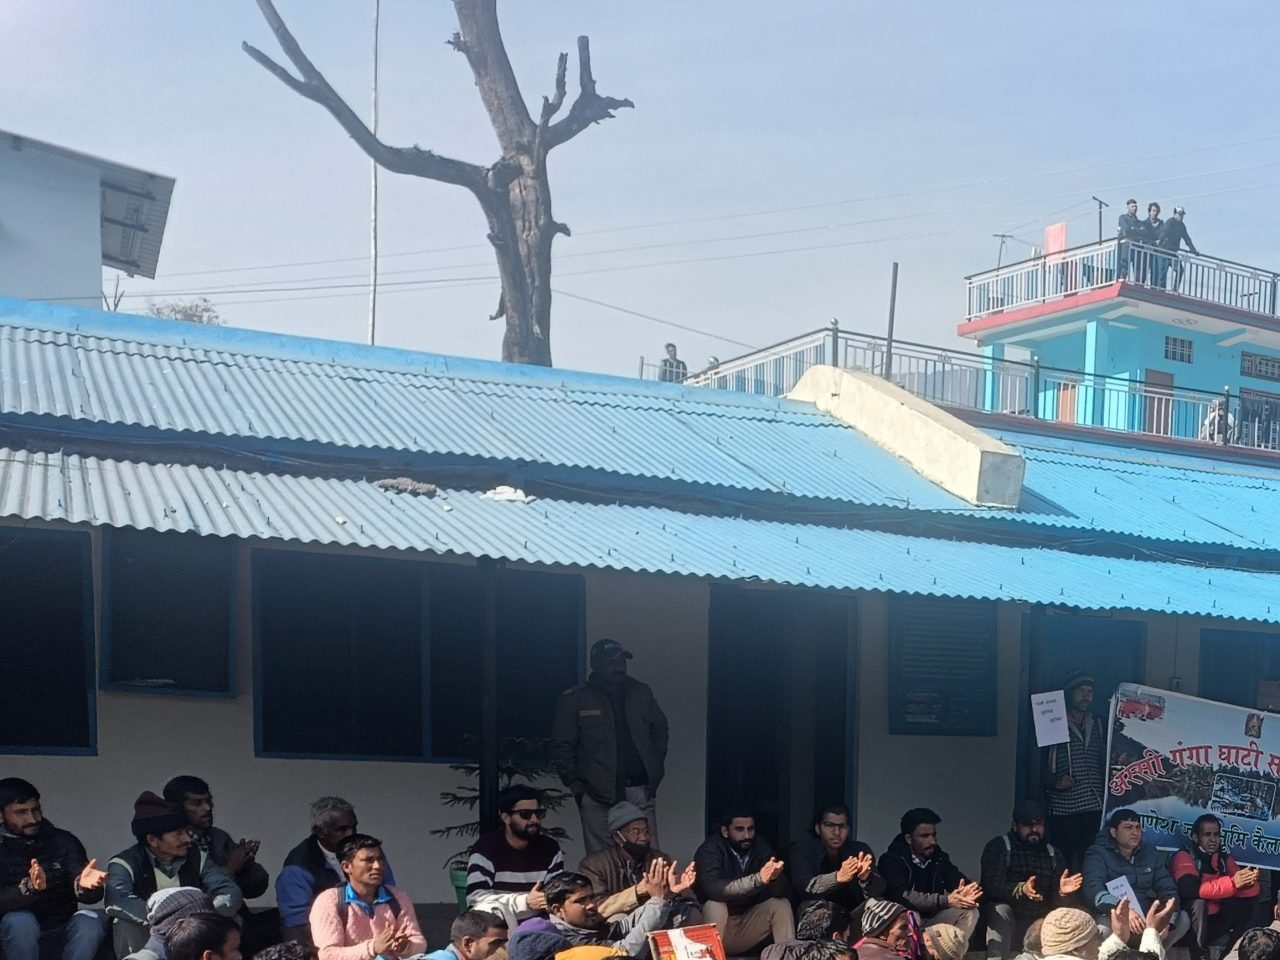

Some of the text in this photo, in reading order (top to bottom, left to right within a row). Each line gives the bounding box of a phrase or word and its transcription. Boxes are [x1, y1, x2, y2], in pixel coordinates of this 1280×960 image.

[1110, 748, 1165, 795] अस्सी
[1169, 740, 1213, 769] गंगा
[1217, 741, 1263, 769] घाटी
